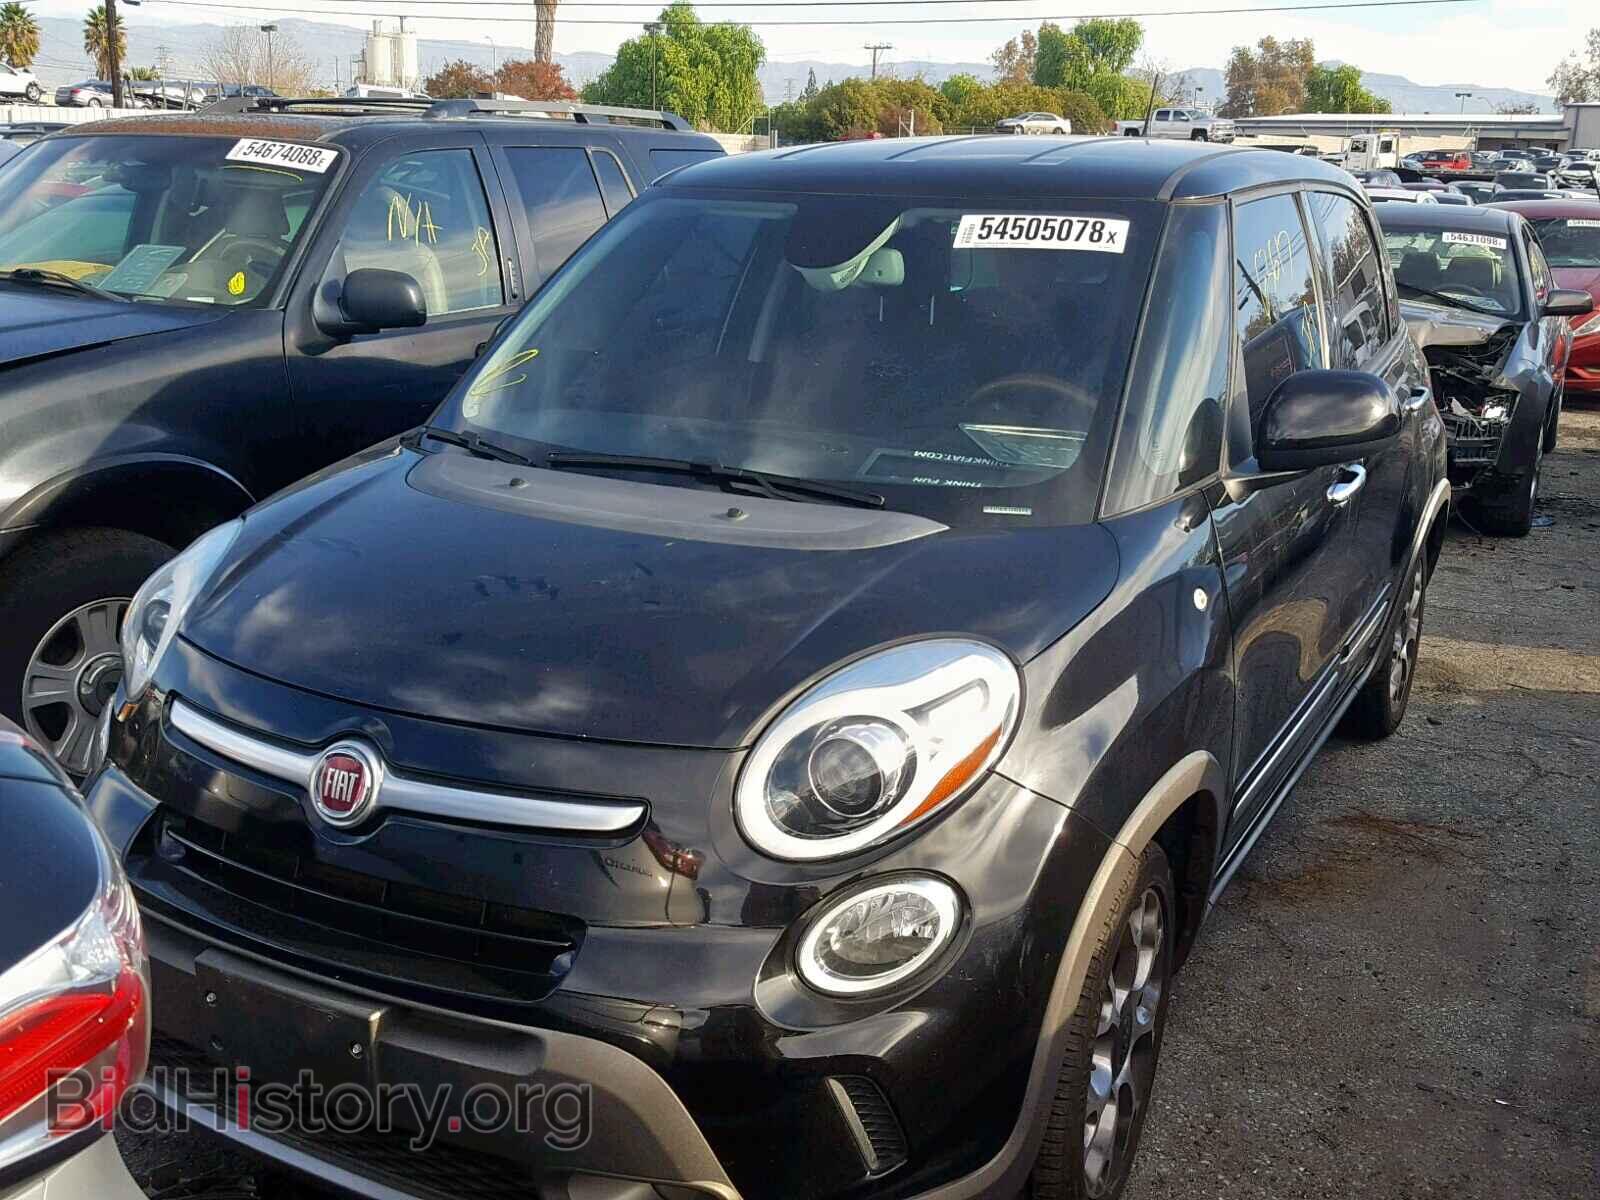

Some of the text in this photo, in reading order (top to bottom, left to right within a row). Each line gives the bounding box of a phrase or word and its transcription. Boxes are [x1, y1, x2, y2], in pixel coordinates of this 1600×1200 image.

[243, 142, 322, 166] 54674088
[978, 217, 1106, 243] 54505078
[323, 767, 360, 803] FIAT
